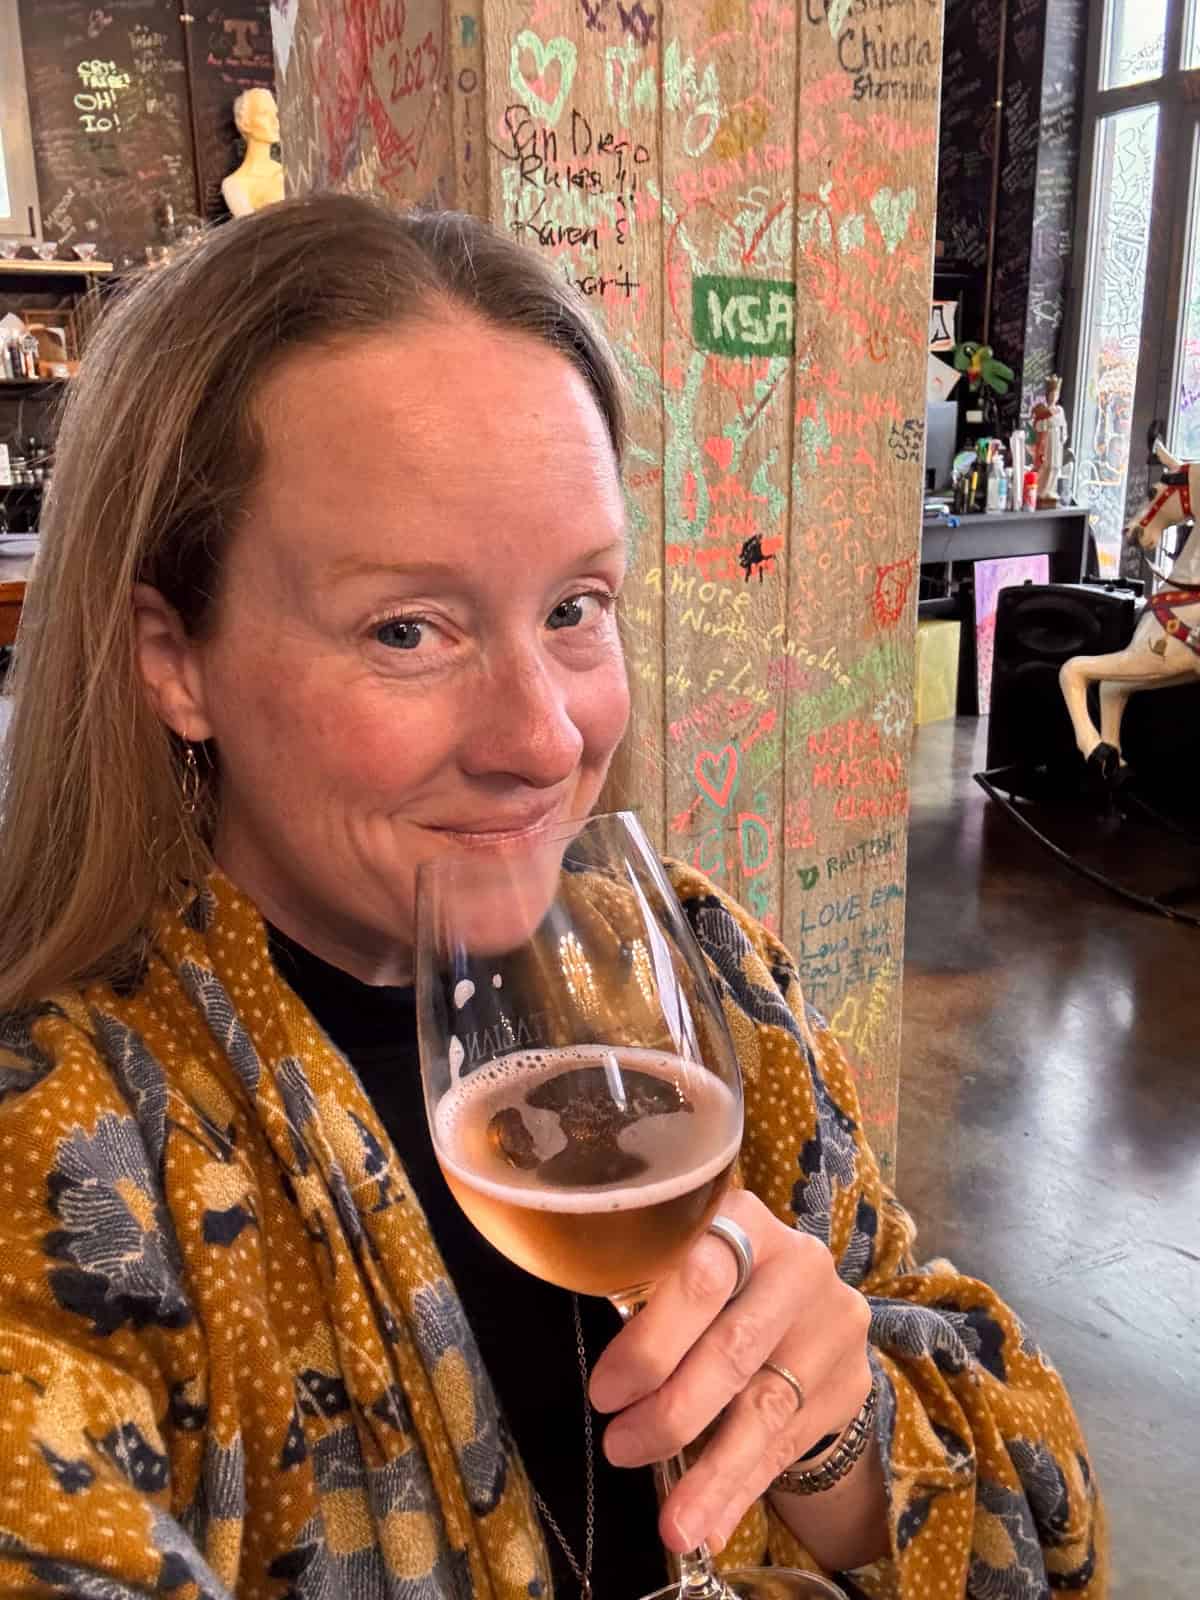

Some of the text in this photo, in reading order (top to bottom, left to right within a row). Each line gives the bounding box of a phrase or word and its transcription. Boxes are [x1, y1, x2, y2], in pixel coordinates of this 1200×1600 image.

[73, 89, 118, 111] OH!
[706, 290, 795, 345] KSA
[800, 894, 862, 934] LOVE
